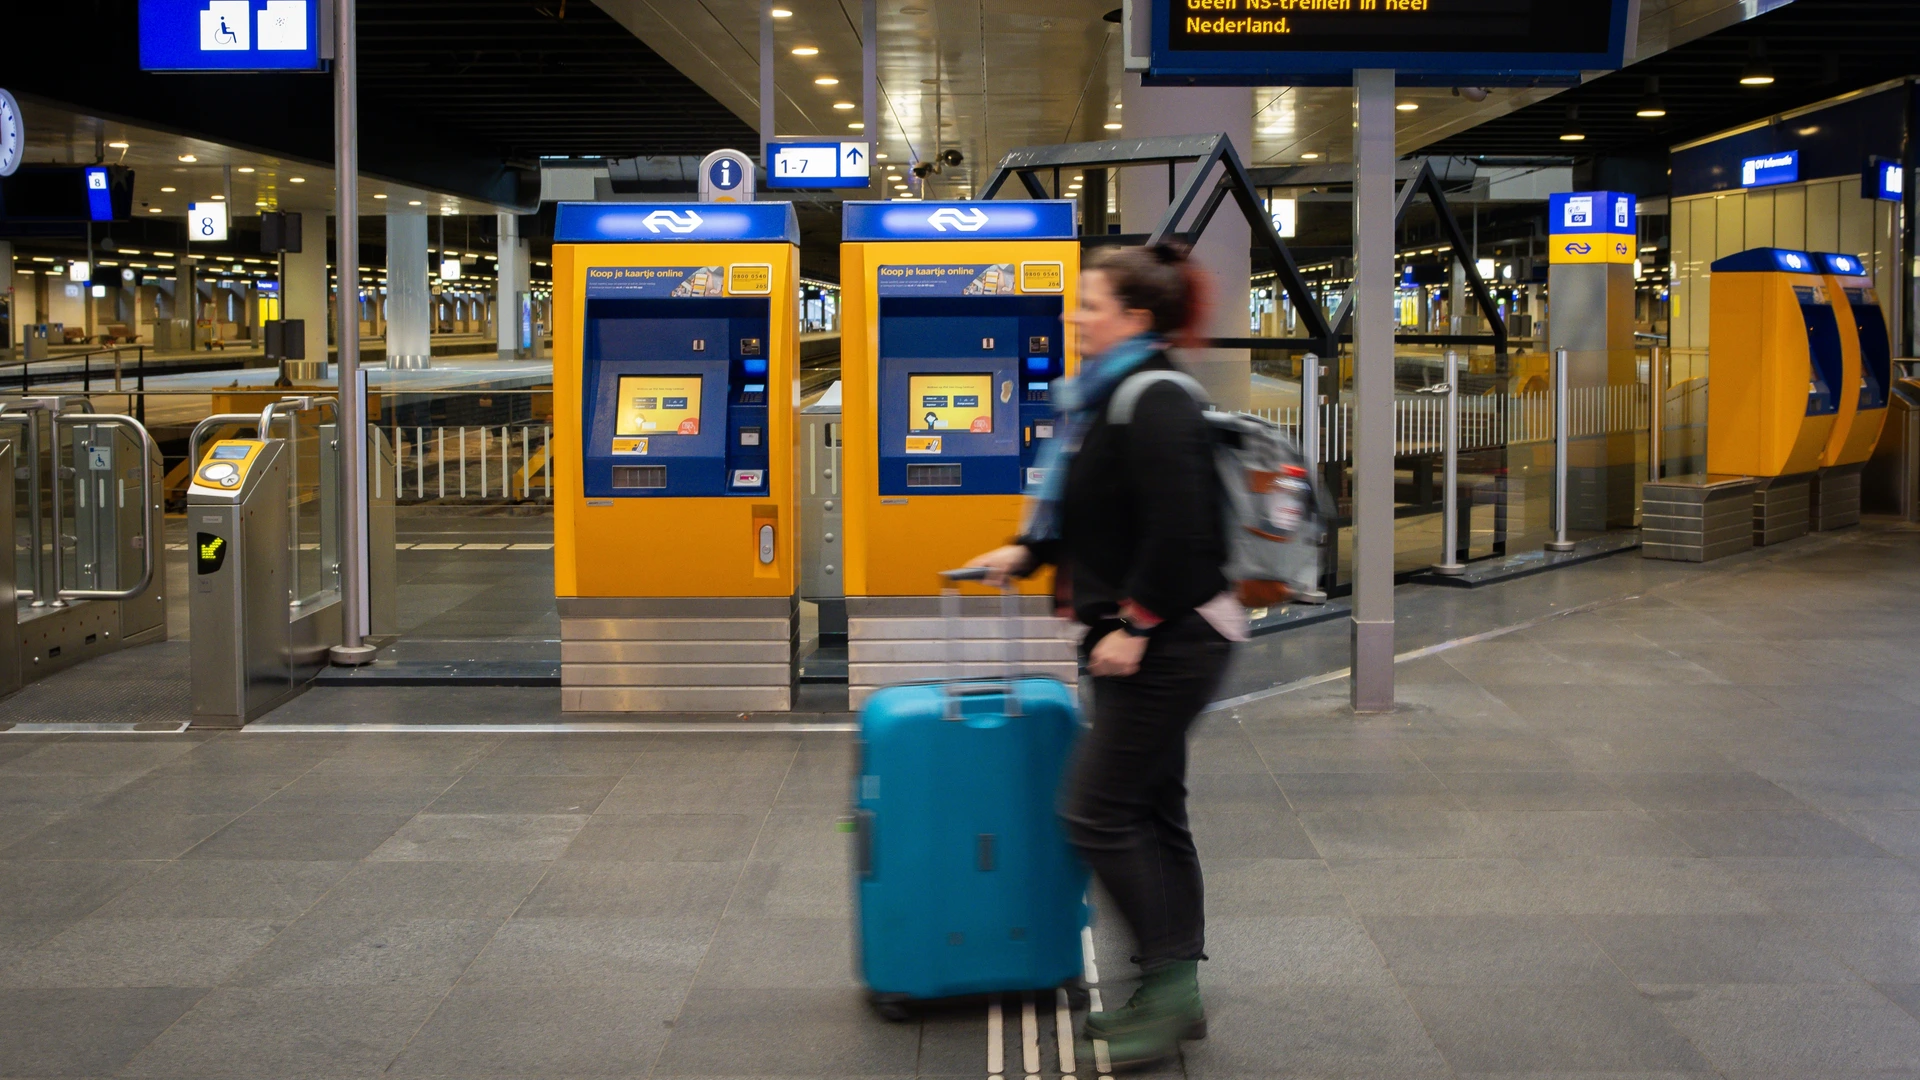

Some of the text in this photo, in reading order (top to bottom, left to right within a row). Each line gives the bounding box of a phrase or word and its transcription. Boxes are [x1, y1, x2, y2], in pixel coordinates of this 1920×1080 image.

[1187, 0, 1236, 10] Geen
[1246, 0, 1351, 10] NS-treinen
[1360, 0, 1377, 10] in
[1186, 17, 1291, 33] Nederland.
[781, 159, 808, 174] 1-7
[94, 178, 101, 187] 8
[201, 217, 214, 236] 8
[590, 269, 683, 279] Koop je kaartje online
[880, 267, 974, 277] Koop je kaartje online
